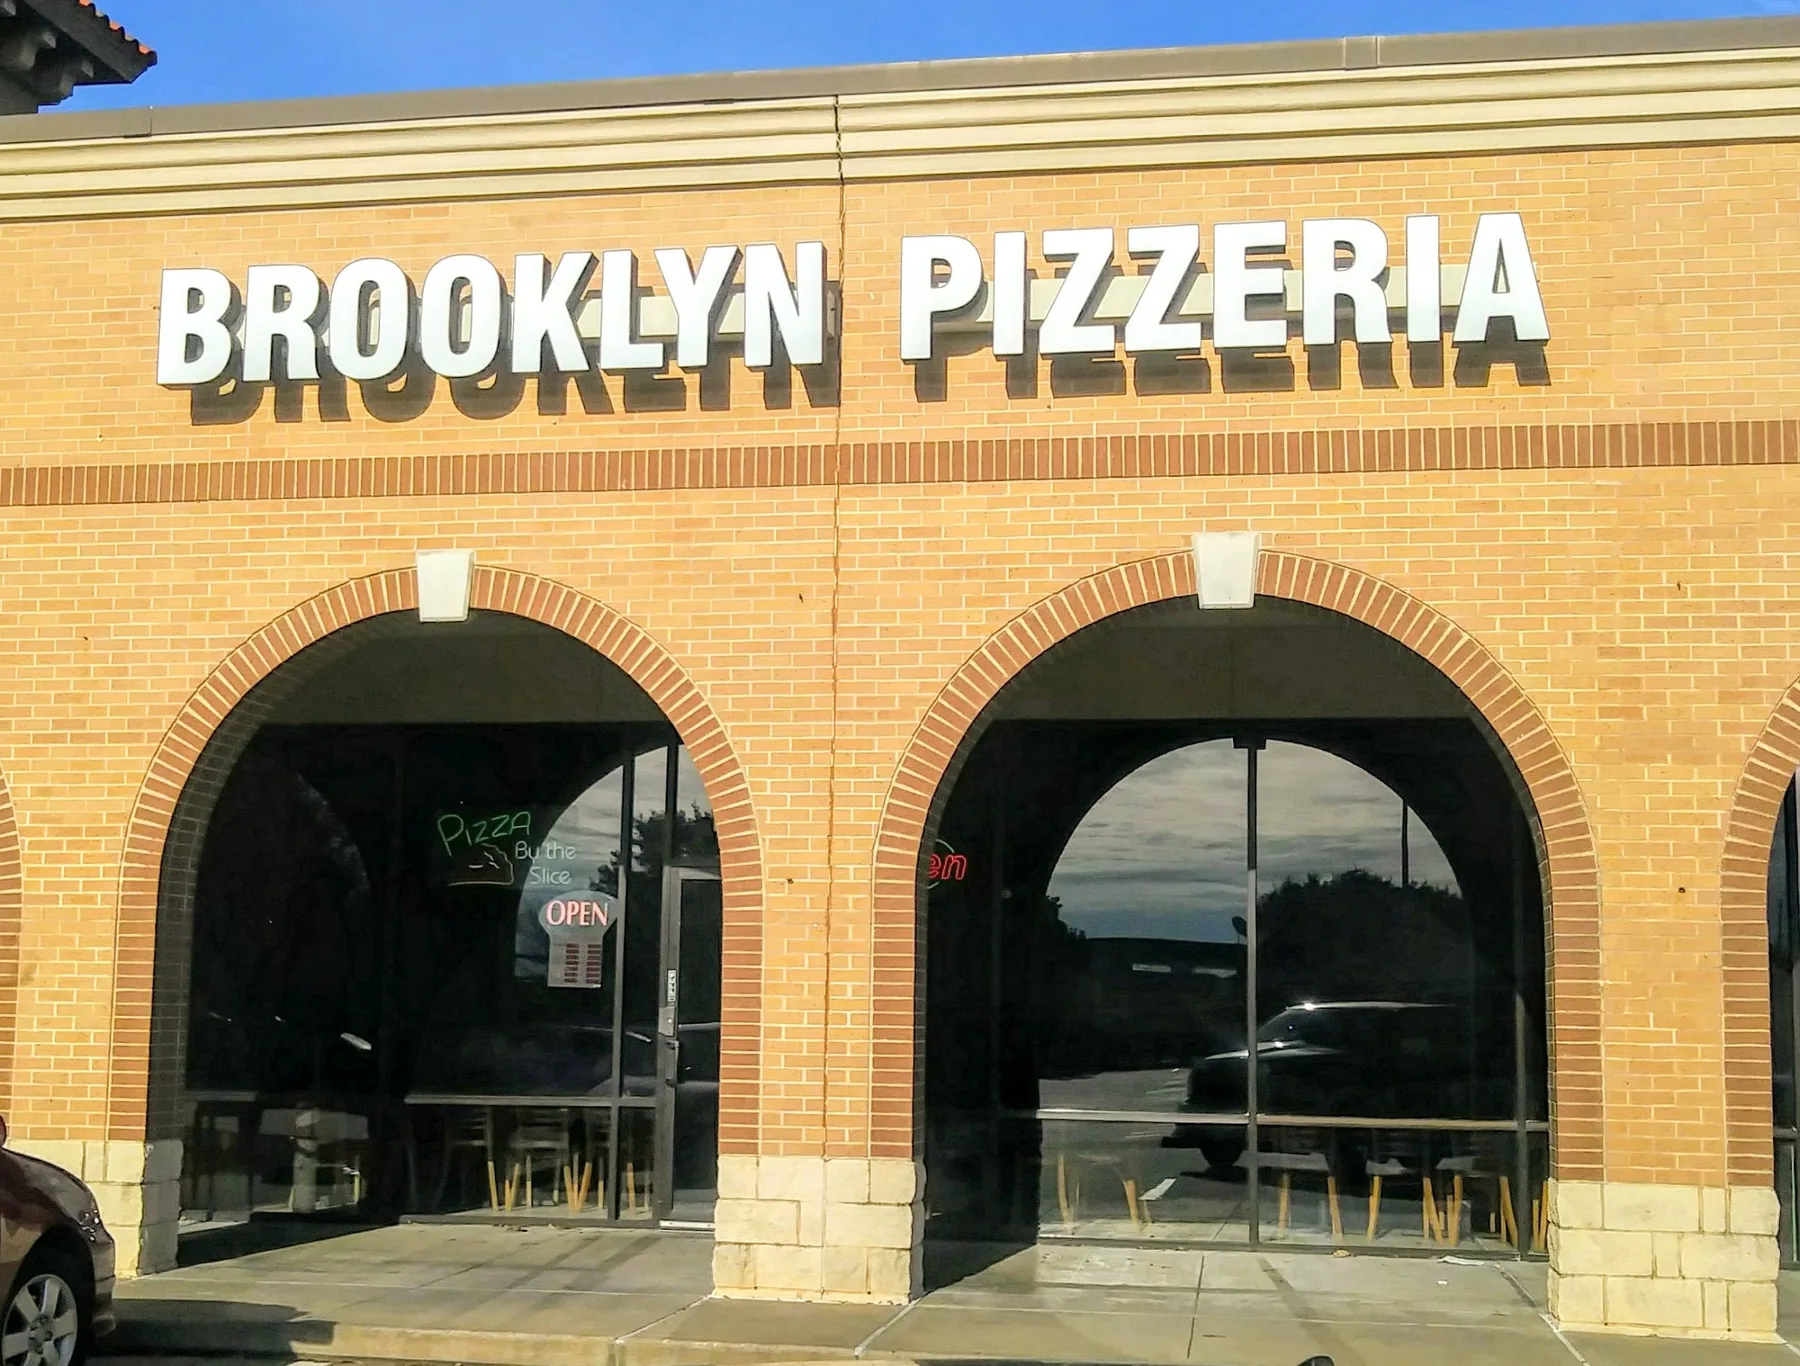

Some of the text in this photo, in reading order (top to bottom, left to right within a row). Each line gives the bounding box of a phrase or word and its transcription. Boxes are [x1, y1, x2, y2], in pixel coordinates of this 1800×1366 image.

[157, 212, 1552, 388] BROOKLYN PIZZERIA
[515, 840, 577, 865] By the
[529, 866, 572, 885] Slice
[546, 900, 609, 927] OPEN
